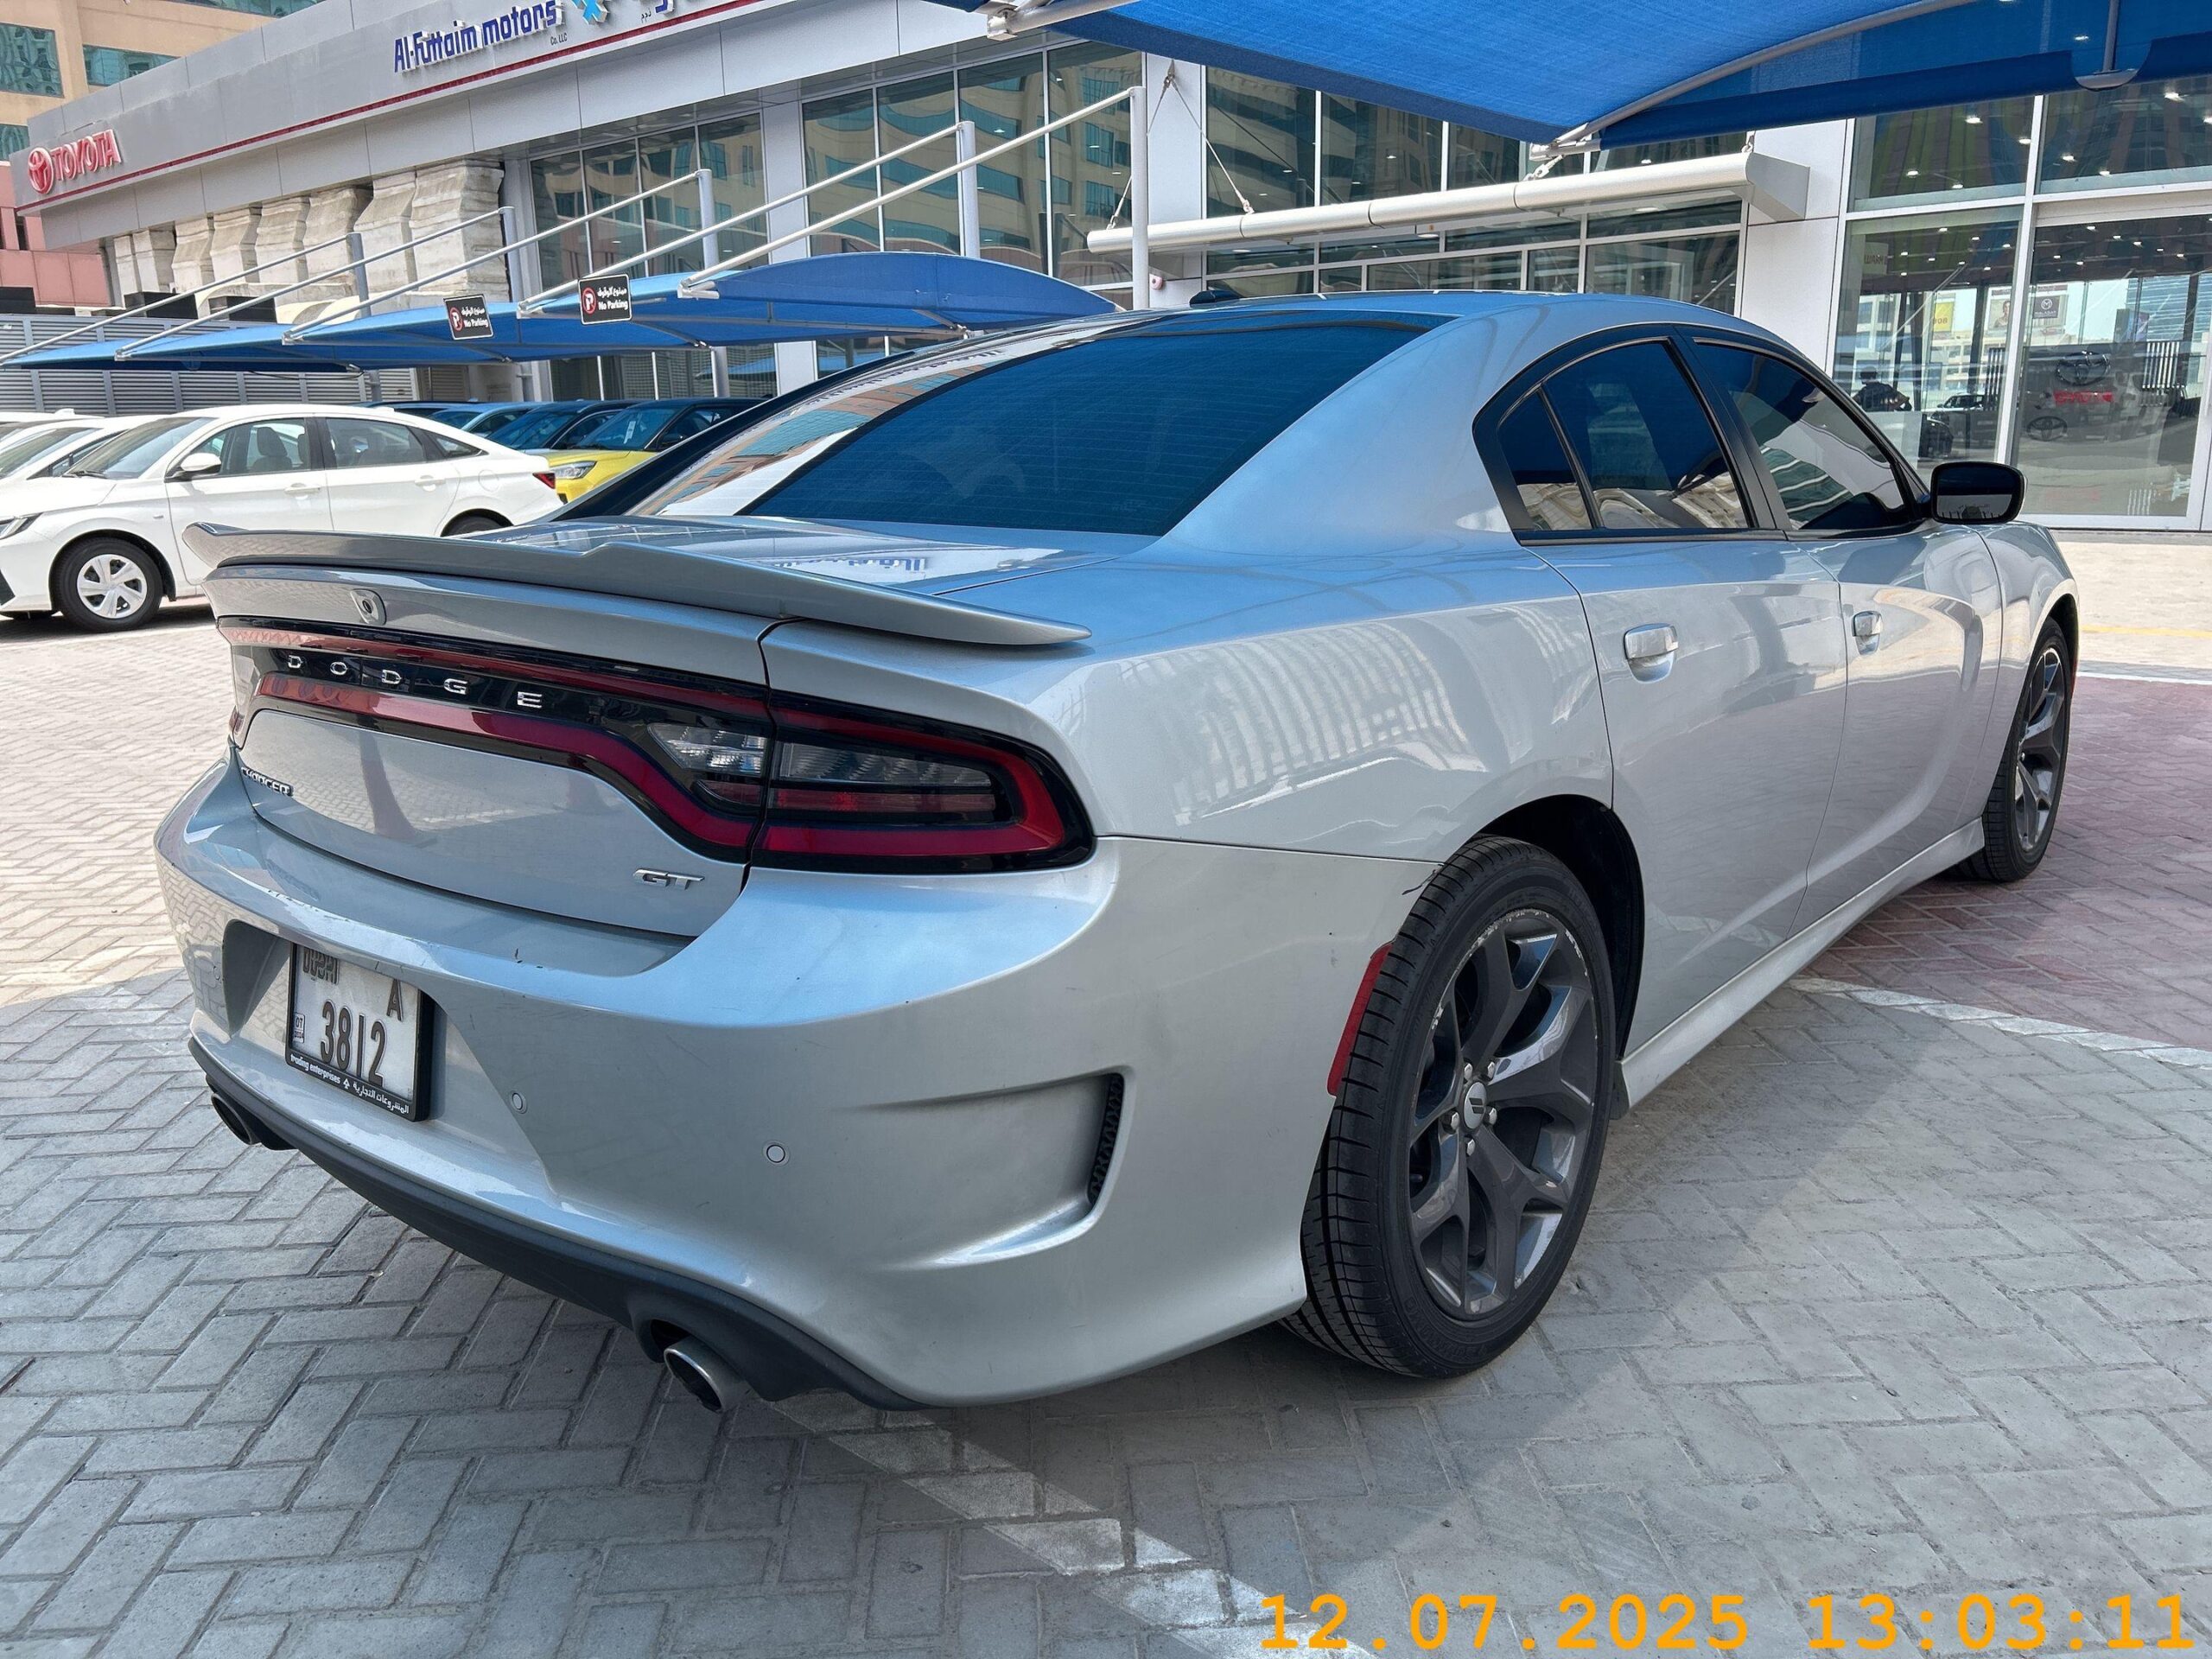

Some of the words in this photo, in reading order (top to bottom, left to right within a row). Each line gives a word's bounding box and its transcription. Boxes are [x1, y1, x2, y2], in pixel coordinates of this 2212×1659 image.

[394, 20, 482, 73] Al-Futtaim
[482, 0, 558, 46] motors
[558, 32, 568, 43] LLC
[49, 129, 122, 181] TOYOTA
[598, 301, 607, 310] No
[607, 299, 628, 310] Parking
[288, 654, 543, 709] DODGE
[632, 868, 706, 891] GT
[386, 978, 404, 1021] A
[321, 1000, 386, 1087] 3812
[309, 1064, 341, 1084] enterprises
